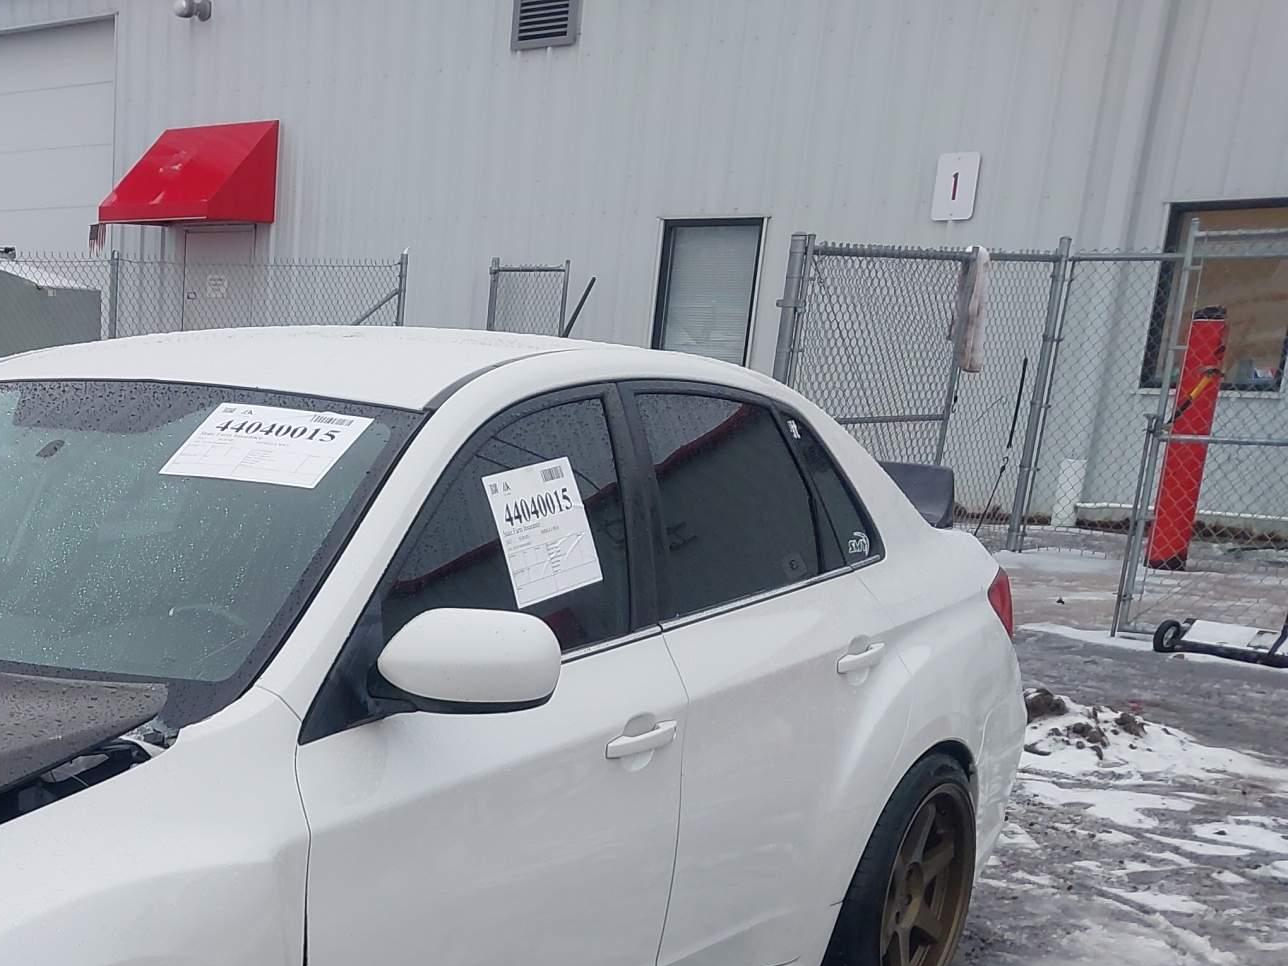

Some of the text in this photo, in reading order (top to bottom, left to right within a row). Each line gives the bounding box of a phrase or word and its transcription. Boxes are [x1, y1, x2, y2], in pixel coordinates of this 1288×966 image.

[952, 172, 959, 200] 1
[215, 419, 342, 443] 44040015
[504, 487, 573, 527] 44040015
